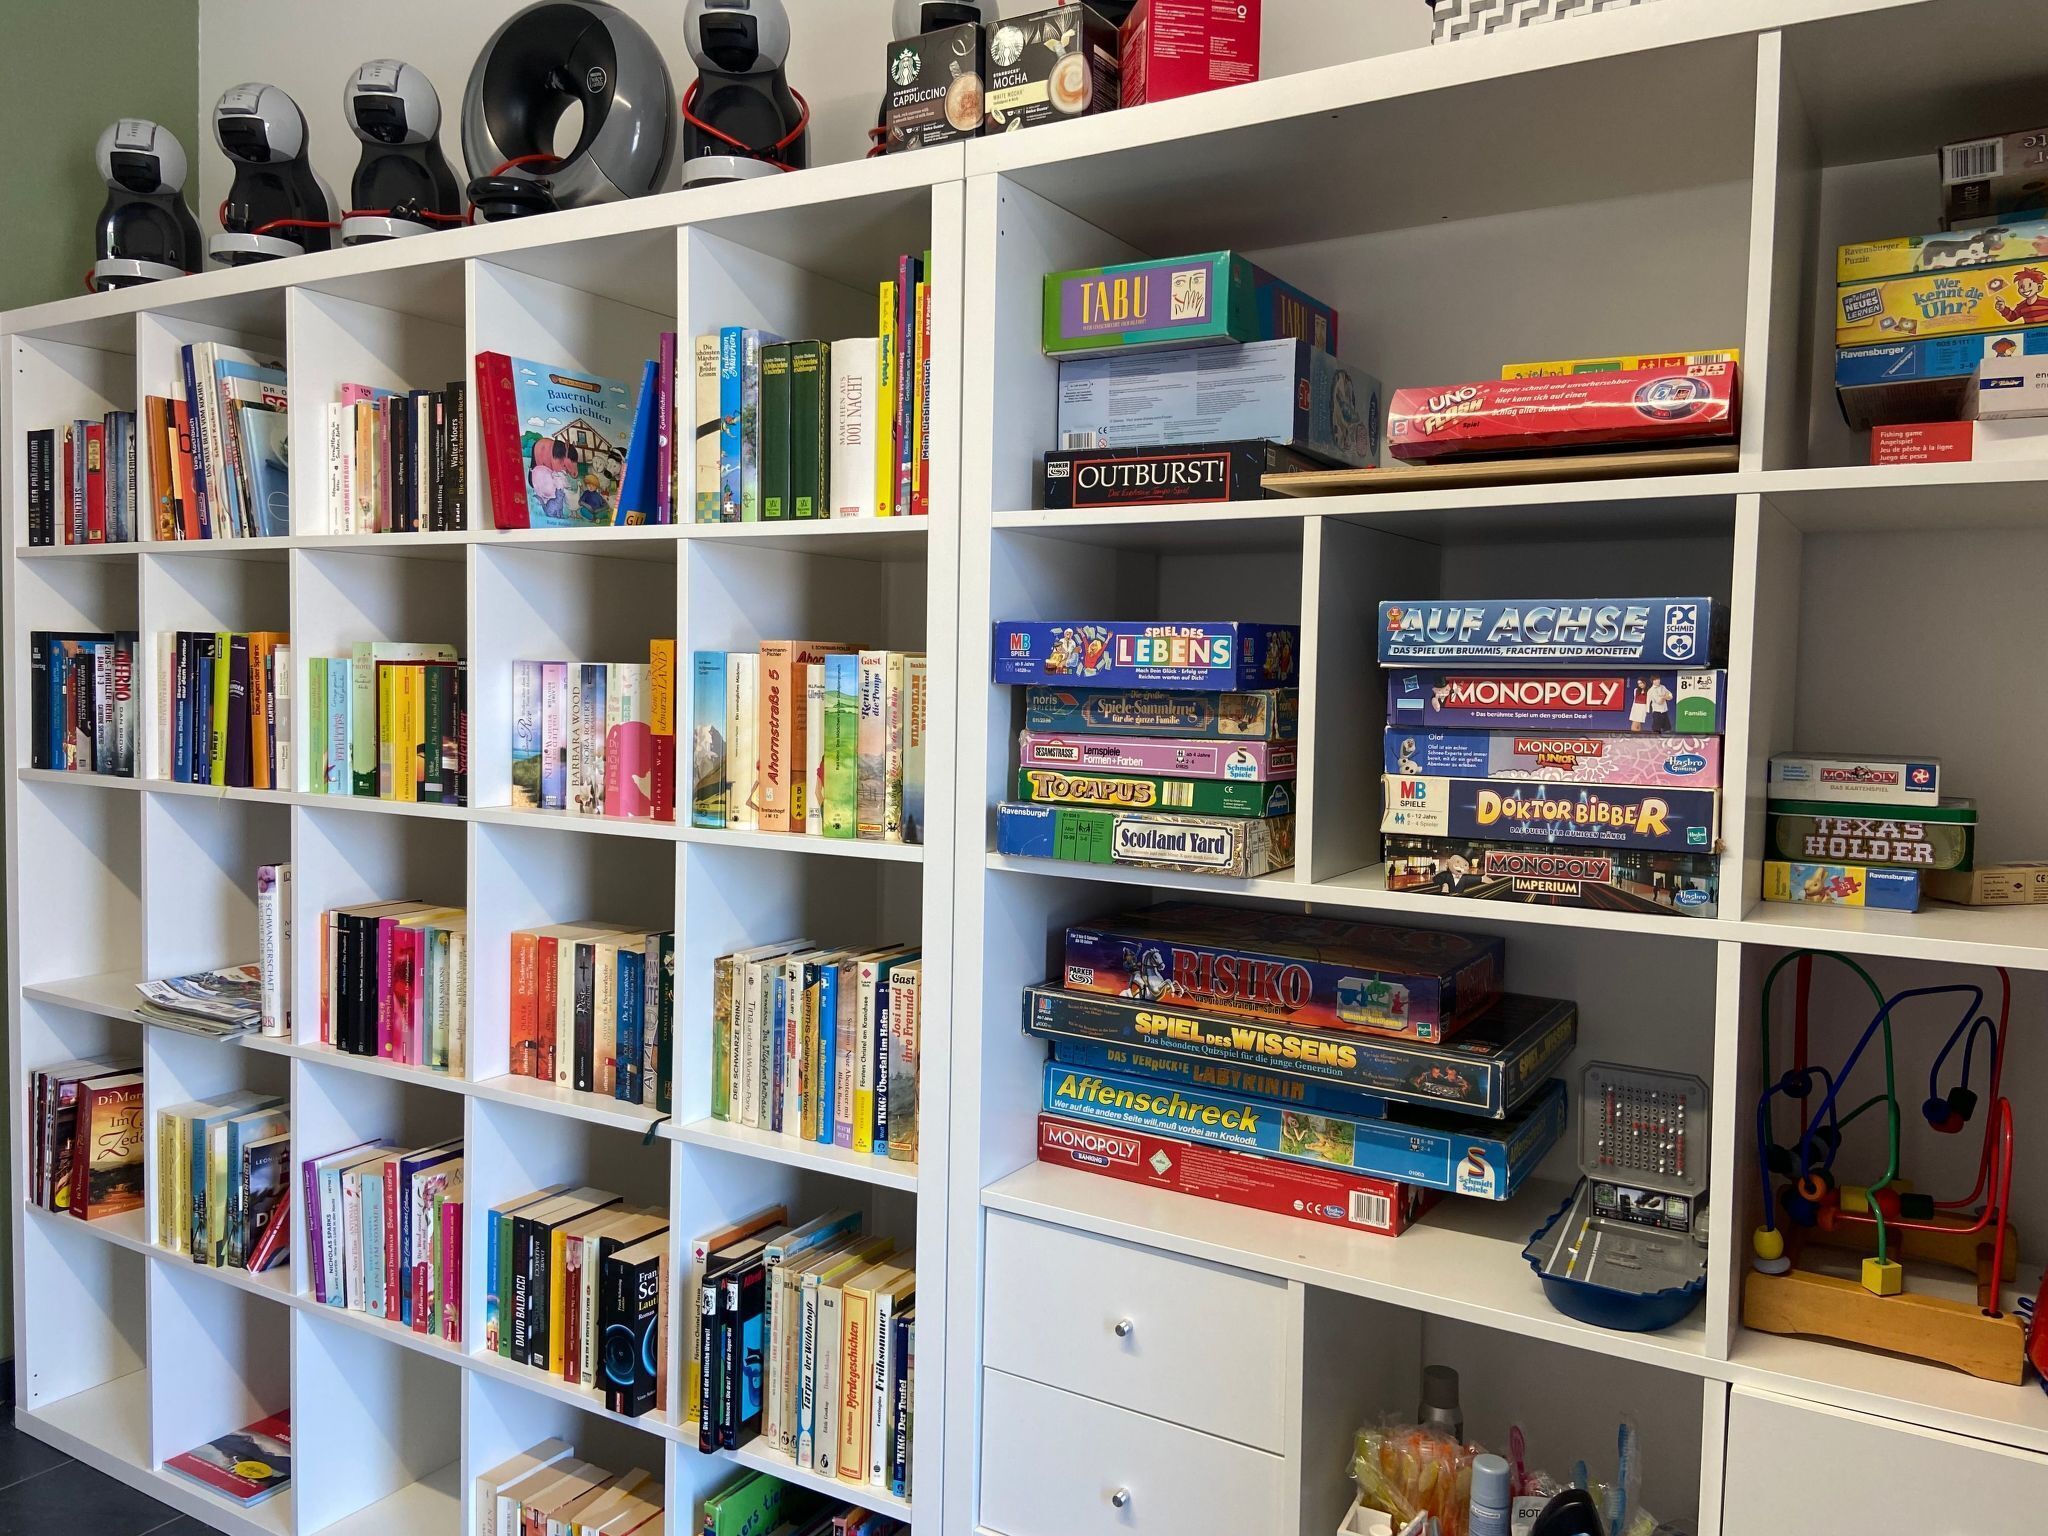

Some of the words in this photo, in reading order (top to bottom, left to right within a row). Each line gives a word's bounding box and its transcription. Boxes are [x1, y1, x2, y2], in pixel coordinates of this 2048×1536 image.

[993, 72, 1028, 89] MOCHA
[893, 86, 946, 107] CAPPUCCINO
[1844, 242, 1900, 257] Ravensburger
[1844, 256, 1870, 266] Puzzle
[1933, 278, 1961, 289] Wer
[1080, 275, 1149, 324] TABU
[1845, 297, 1879, 312] NEUES
[1912, 286, 1964, 306] kennt
[1965, 287, 1984, 299] die
[1847, 305, 1881, 320] LERNEN
[1921, 300, 1978, 320] Uhr?
[1840, 345, 1905, 360] Ravensburger
[196, 382, 205, 408] KOCHEN
[263, 386, 275, 394] DR.
[847, 375, 862, 418] NACHT
[1521, 384, 1548, 393] schnell
[1428, 387, 1476, 412] UNO
[546, 403, 612, 424] Geschichten
[847, 423, 861, 446] 1001
[1880, 431, 1903, 439] Fishing
[1880, 438, 1913, 447] Angelspiel
[450, 444, 458, 468] Walter
[1078, 460, 1224, 490] OUTBURST!
[1144, 627, 1179, 638] SPIEL
[1182, 627, 1204, 638] DES
[1390, 606, 1486, 644] AUF
[1486, 606, 1651, 644] ACHSE
[1010, 633, 1030, 650] MB
[1119, 638, 1230, 664] LEBENS
[1392, 647, 1412, 655] DAS
[1412, 647, 1437, 655] SPIEL
[1438, 647, 1454, 655] UM
[1455, 647, 1503, 656] BRUMMIS,
[1505, 647, 1553, 655] FRACHTEN
[1558, 647, 1583, 655] UND
[1584, 648, 1637, 656] MONETEN
[657, 651, 668, 690] LAND
[860, 656, 881, 666] Gast
[114, 651, 132, 701] INFERNO
[768, 669, 780, 681] 5
[872, 673, 881, 701] Ponys
[1450, 681, 1619, 706] MONOPOLY
[572, 686, 580, 724] WOOD
[1033, 695, 1057, 705] noris
[1097, 698, 1198, 722] Spiele-Sammlung
[766, 685, 779, 785] Ahornstraße
[572, 728, 580, 787] BARBARA
[1035, 747, 1074, 759] SESAMSTRASSE
[1084, 746, 1121, 757] Lernspiele
[1517, 741, 1599, 755] MONOPOLY
[1226, 764, 1256, 773] Schmidt
[1538, 753, 1578, 765] JUNIOR
[1669, 756, 1702, 767] Hasbro
[1230, 771, 1253, 779] Spiele
[1822, 770, 1897, 783] MONOPOLY
[1032, 773, 1151, 803] TOCAPUS
[1400, 781, 1426, 800] MB
[1001, 807, 1050, 818] Ravensburger
[1475, 789, 1571, 825] DOKTOR
[1575, 796, 1670, 836] BIBBER
[1814, 817, 1924, 839] TEXAS
[1121, 829, 1186, 851] Scotland
[1190, 832, 1225, 854] Yard
[1805, 836, 1933, 863] HOLDER
[1489, 854, 1607, 878] MONOPOLY
[1516, 879, 1577, 893] IMPERIUM
[1869, 872, 1915, 882] Ravensburger
[265, 902, 274, 993] SCHWANGERSCHAFT
[891, 973, 916, 985] Gast
[1069, 966, 1093, 976] PARKER
[1170, 947, 1314, 1010] RISIKO
[892, 987, 901, 1010] und
[880, 1009, 889, 1038] Hafen
[903, 988, 914, 1038] Freunde
[892, 1012, 901, 1037] Josi
[880, 1040, 888, 1051] im
[902, 1039, 913, 1064] ihre
[1134, 1012, 1205, 1044] SPIEL
[1206, 1034, 1232, 1047] DES
[1231, 1027, 1357, 1070] WISSENS
[1143, 1036, 1158, 1044] Das
[1160, 1037, 1200, 1053] besondere
[1201, 1045, 1239, 1061] Quizspiel
[1107, 1050, 1127, 1064] DAS
[859, 1065, 867, 1088] Försters
[877, 1052, 888, 1126] TKKG/Überfall
[97, 1094, 113, 1106] Di
[1056, 1074, 1262, 1133] Affenschreck
[110, 1117, 130, 1128] Im
[1054, 1100, 1069, 1109] Wer
[1069, 1103, 1083, 1111] auf
[1095, 1108, 1122, 1120] andere
[1122, 1113, 1143, 1124] Seite
[1178, 1124, 1204, 1136] vorbei
[1219, 1131, 1258, 1147] Krokodil.
[1047, 1128, 1136, 1159] MONOPOLY
[1078, 1152, 1103, 1164] BANKING
[1458, 1175, 1493, 1188] Schmidt
[1462, 1183, 1489, 1194] Spiele
[639, 1269, 657, 1283] Fran
[516, 1274, 525, 1319] BALDACCI
[639, 1297, 657, 1311] Laut
[638, 1310, 655, 1320] Roman
[516, 1315, 525, 1347] DAVID
[875, 1309, 887, 1392] Frühsommer
[803, 1354, 811, 1371] der
[846, 1321, 860, 1410] Pferdegeschichten
[802, 1374, 812, 1410] Tarpa
[898, 1379, 907, 1411] Teufel
[896, 1411, 906, 1465] TKKG/Der
